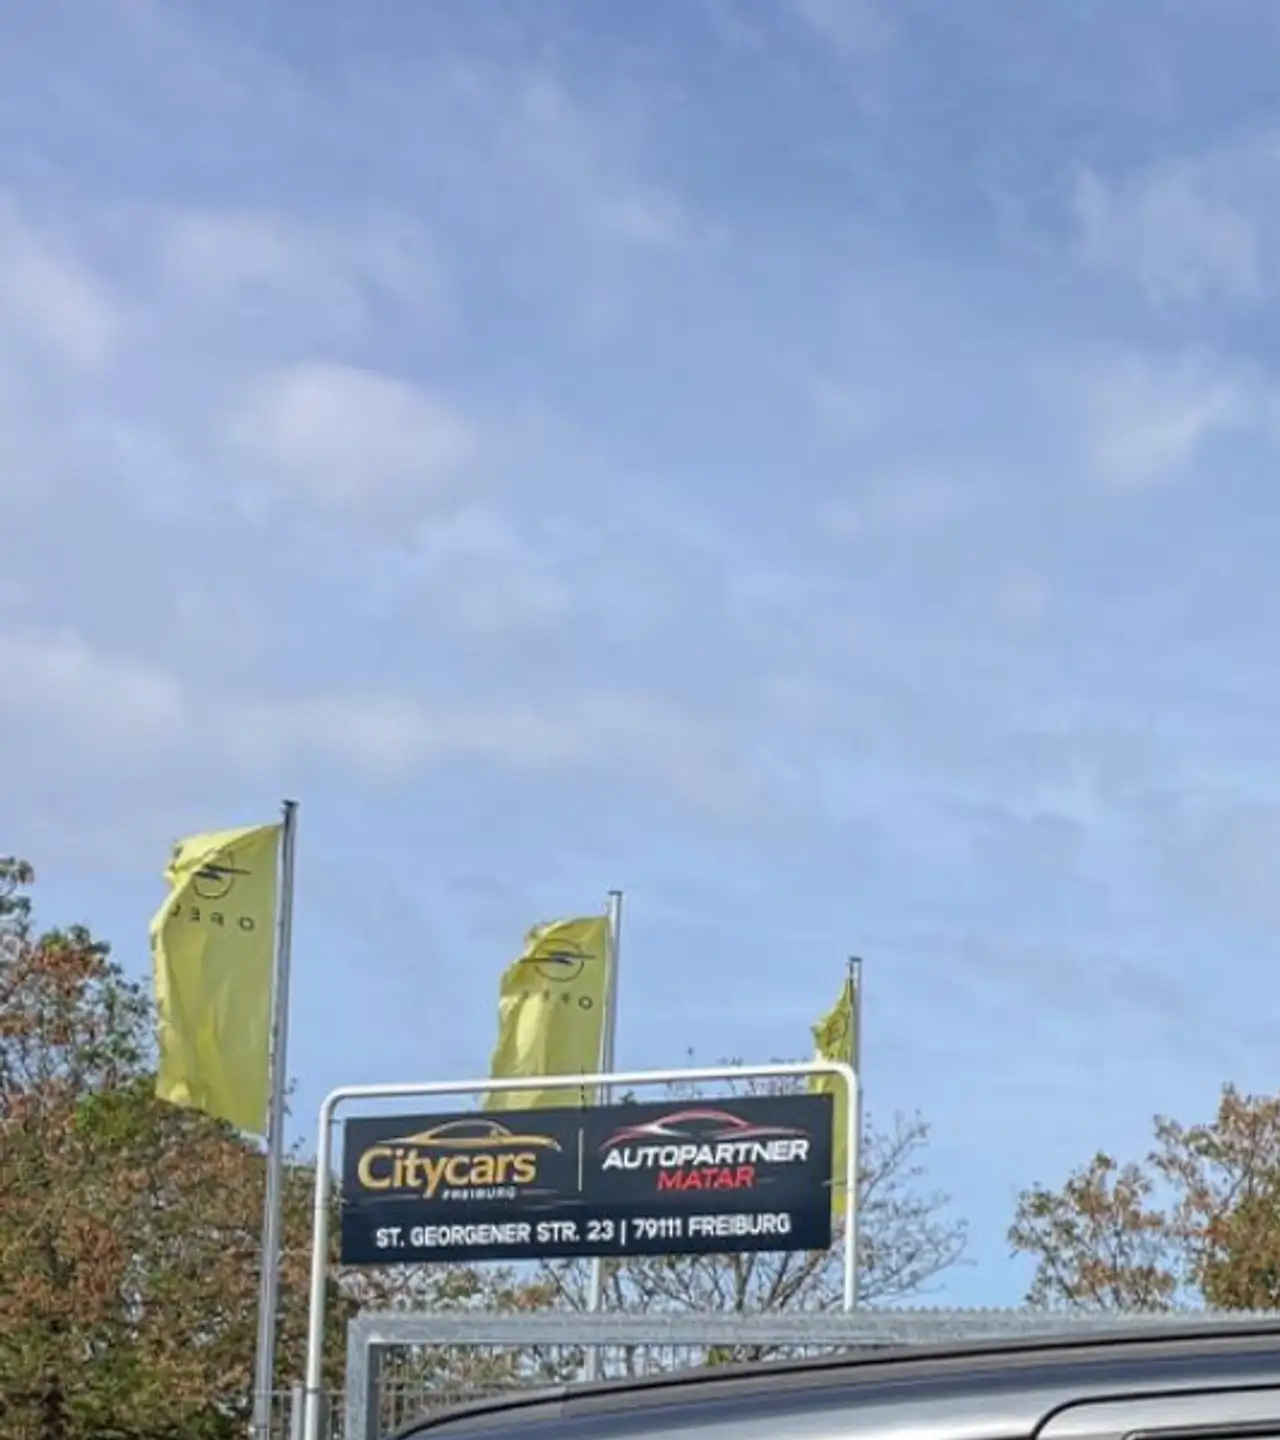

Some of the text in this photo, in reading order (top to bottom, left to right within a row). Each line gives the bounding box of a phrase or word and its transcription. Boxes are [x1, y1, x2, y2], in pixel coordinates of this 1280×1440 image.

[602, 1140, 810, 1170] AUTOPARTNER
[357, 1146, 537, 1199] Citycars
[656, 1166, 756, 1191] MATAR
[376, 1212, 791, 1249] ST. GEORGENER STR. 23 79111 FREIBURG
